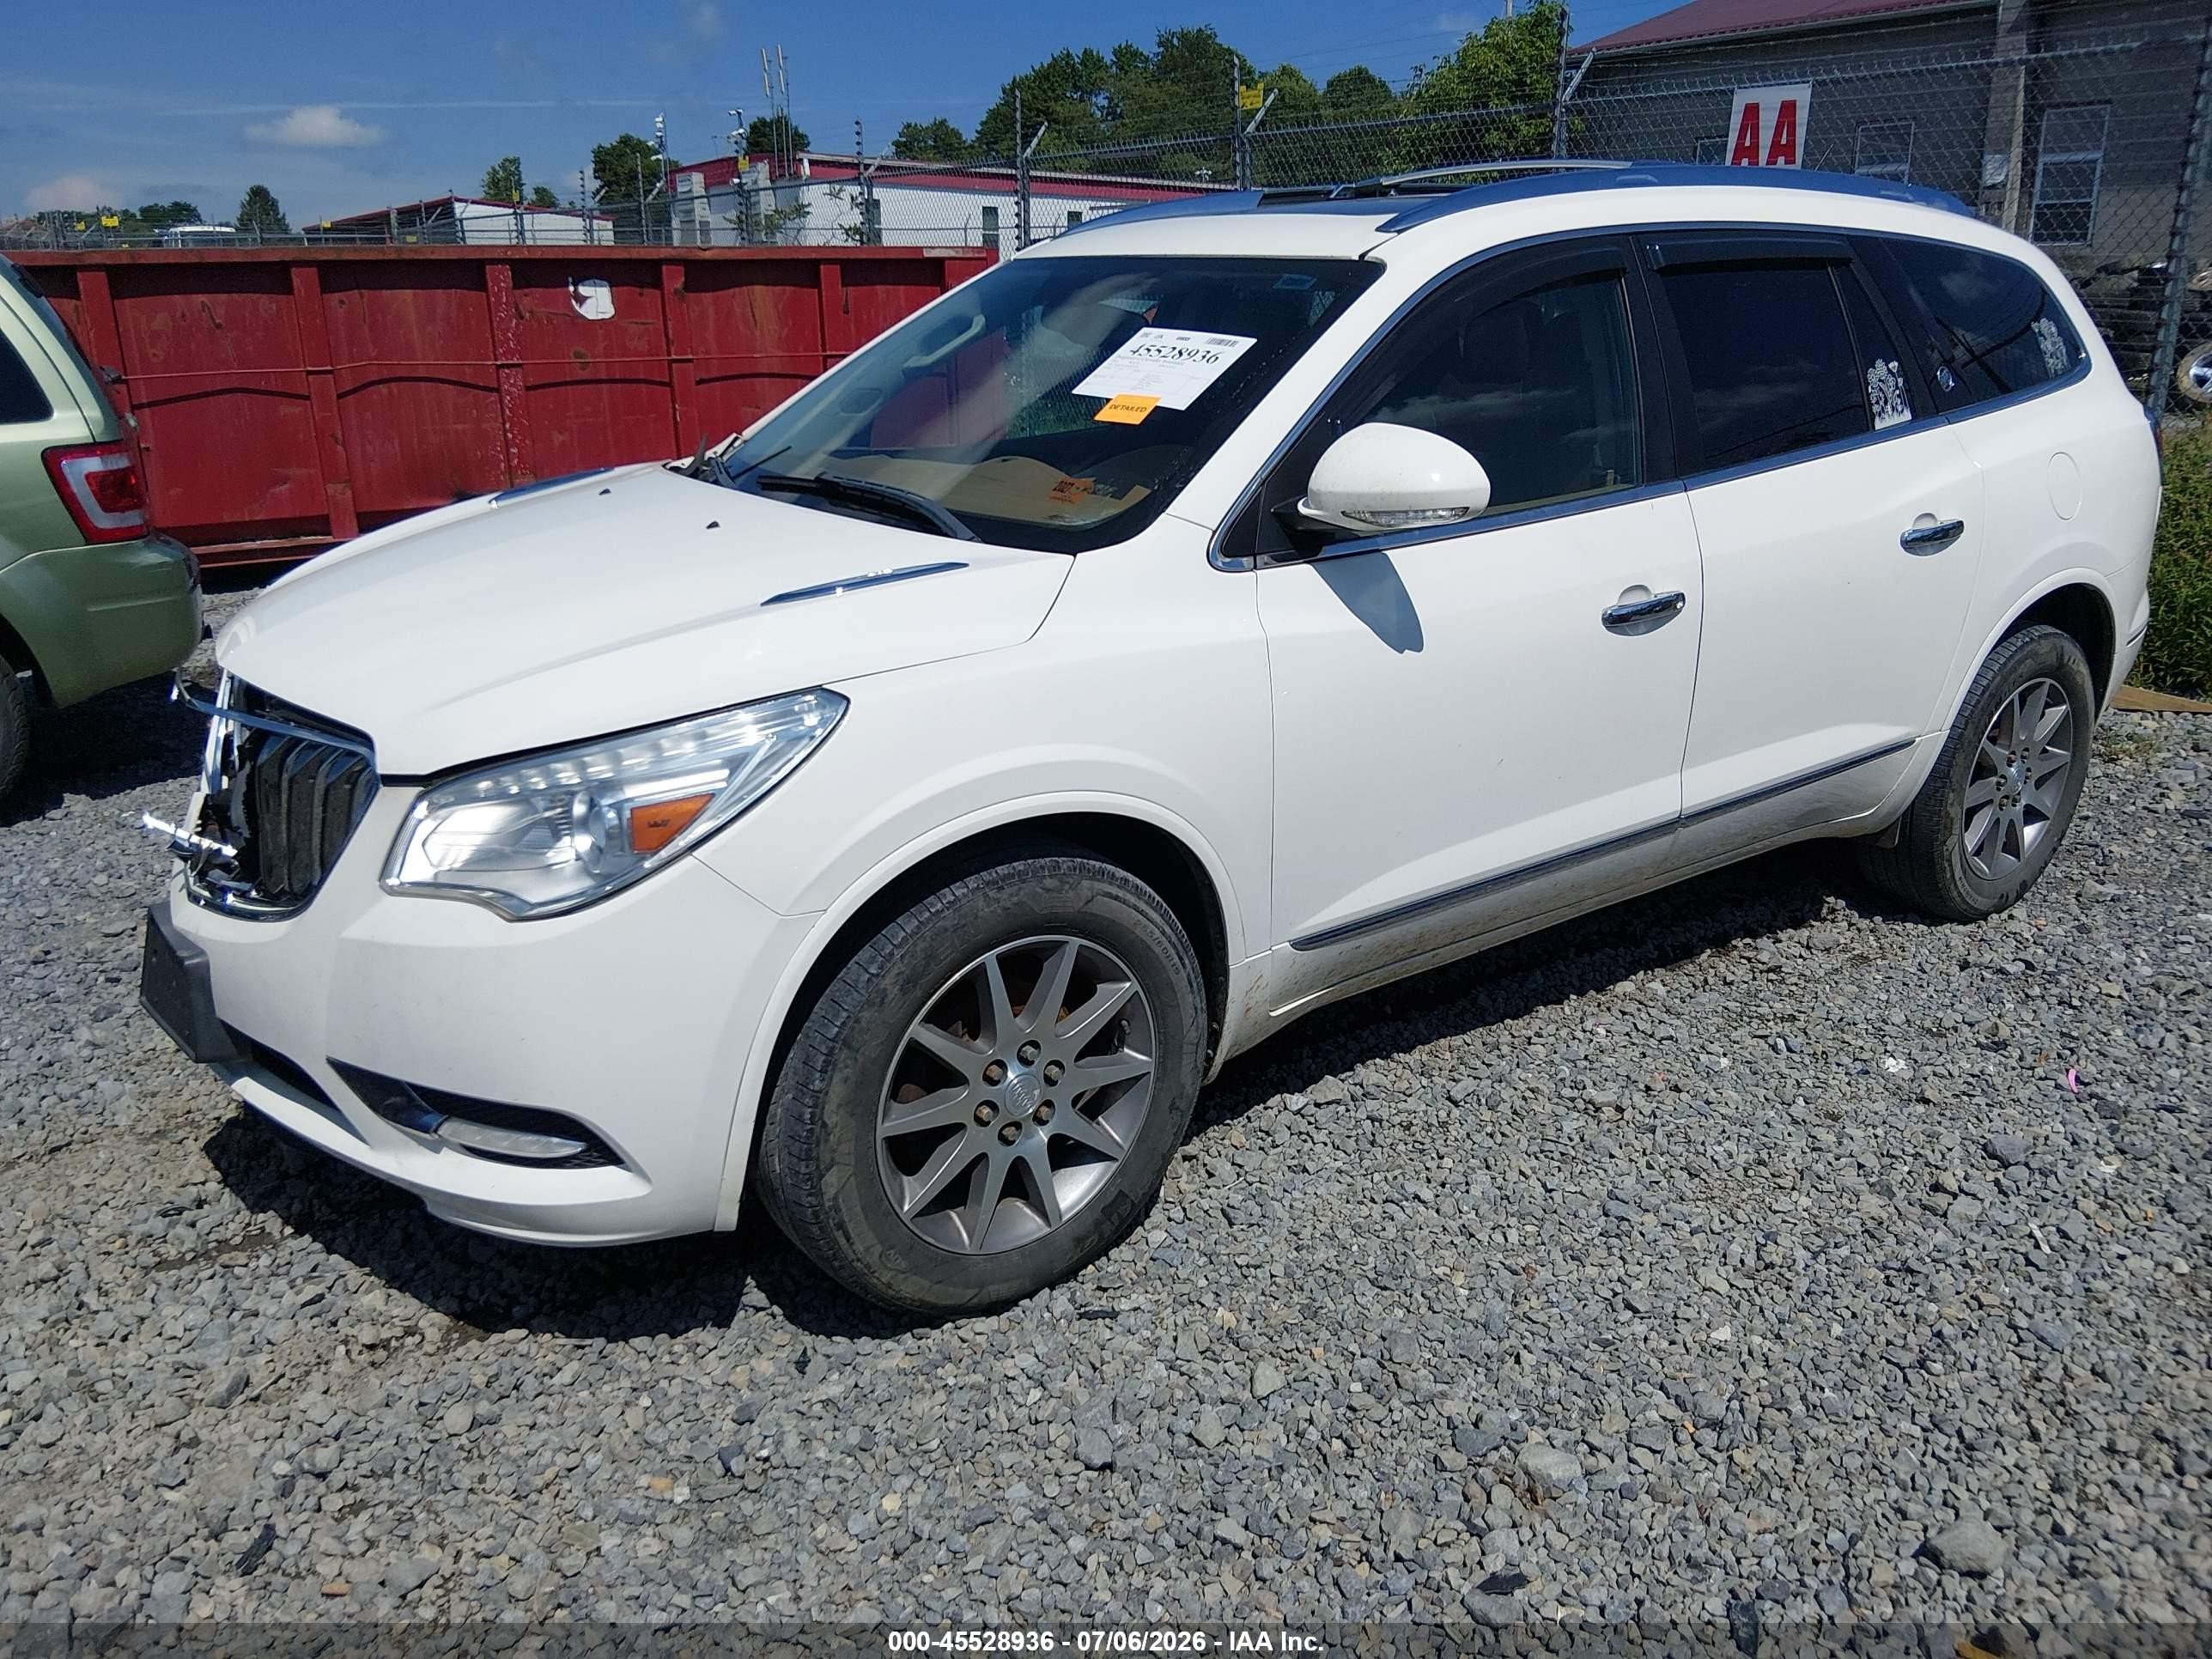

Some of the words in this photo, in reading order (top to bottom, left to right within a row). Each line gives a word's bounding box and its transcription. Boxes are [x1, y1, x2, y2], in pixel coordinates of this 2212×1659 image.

[1731, 100, 1797, 167] AA
[1130, 343, 1226, 364] 45528936
[1109, 404, 1147, 413] DETAILED
